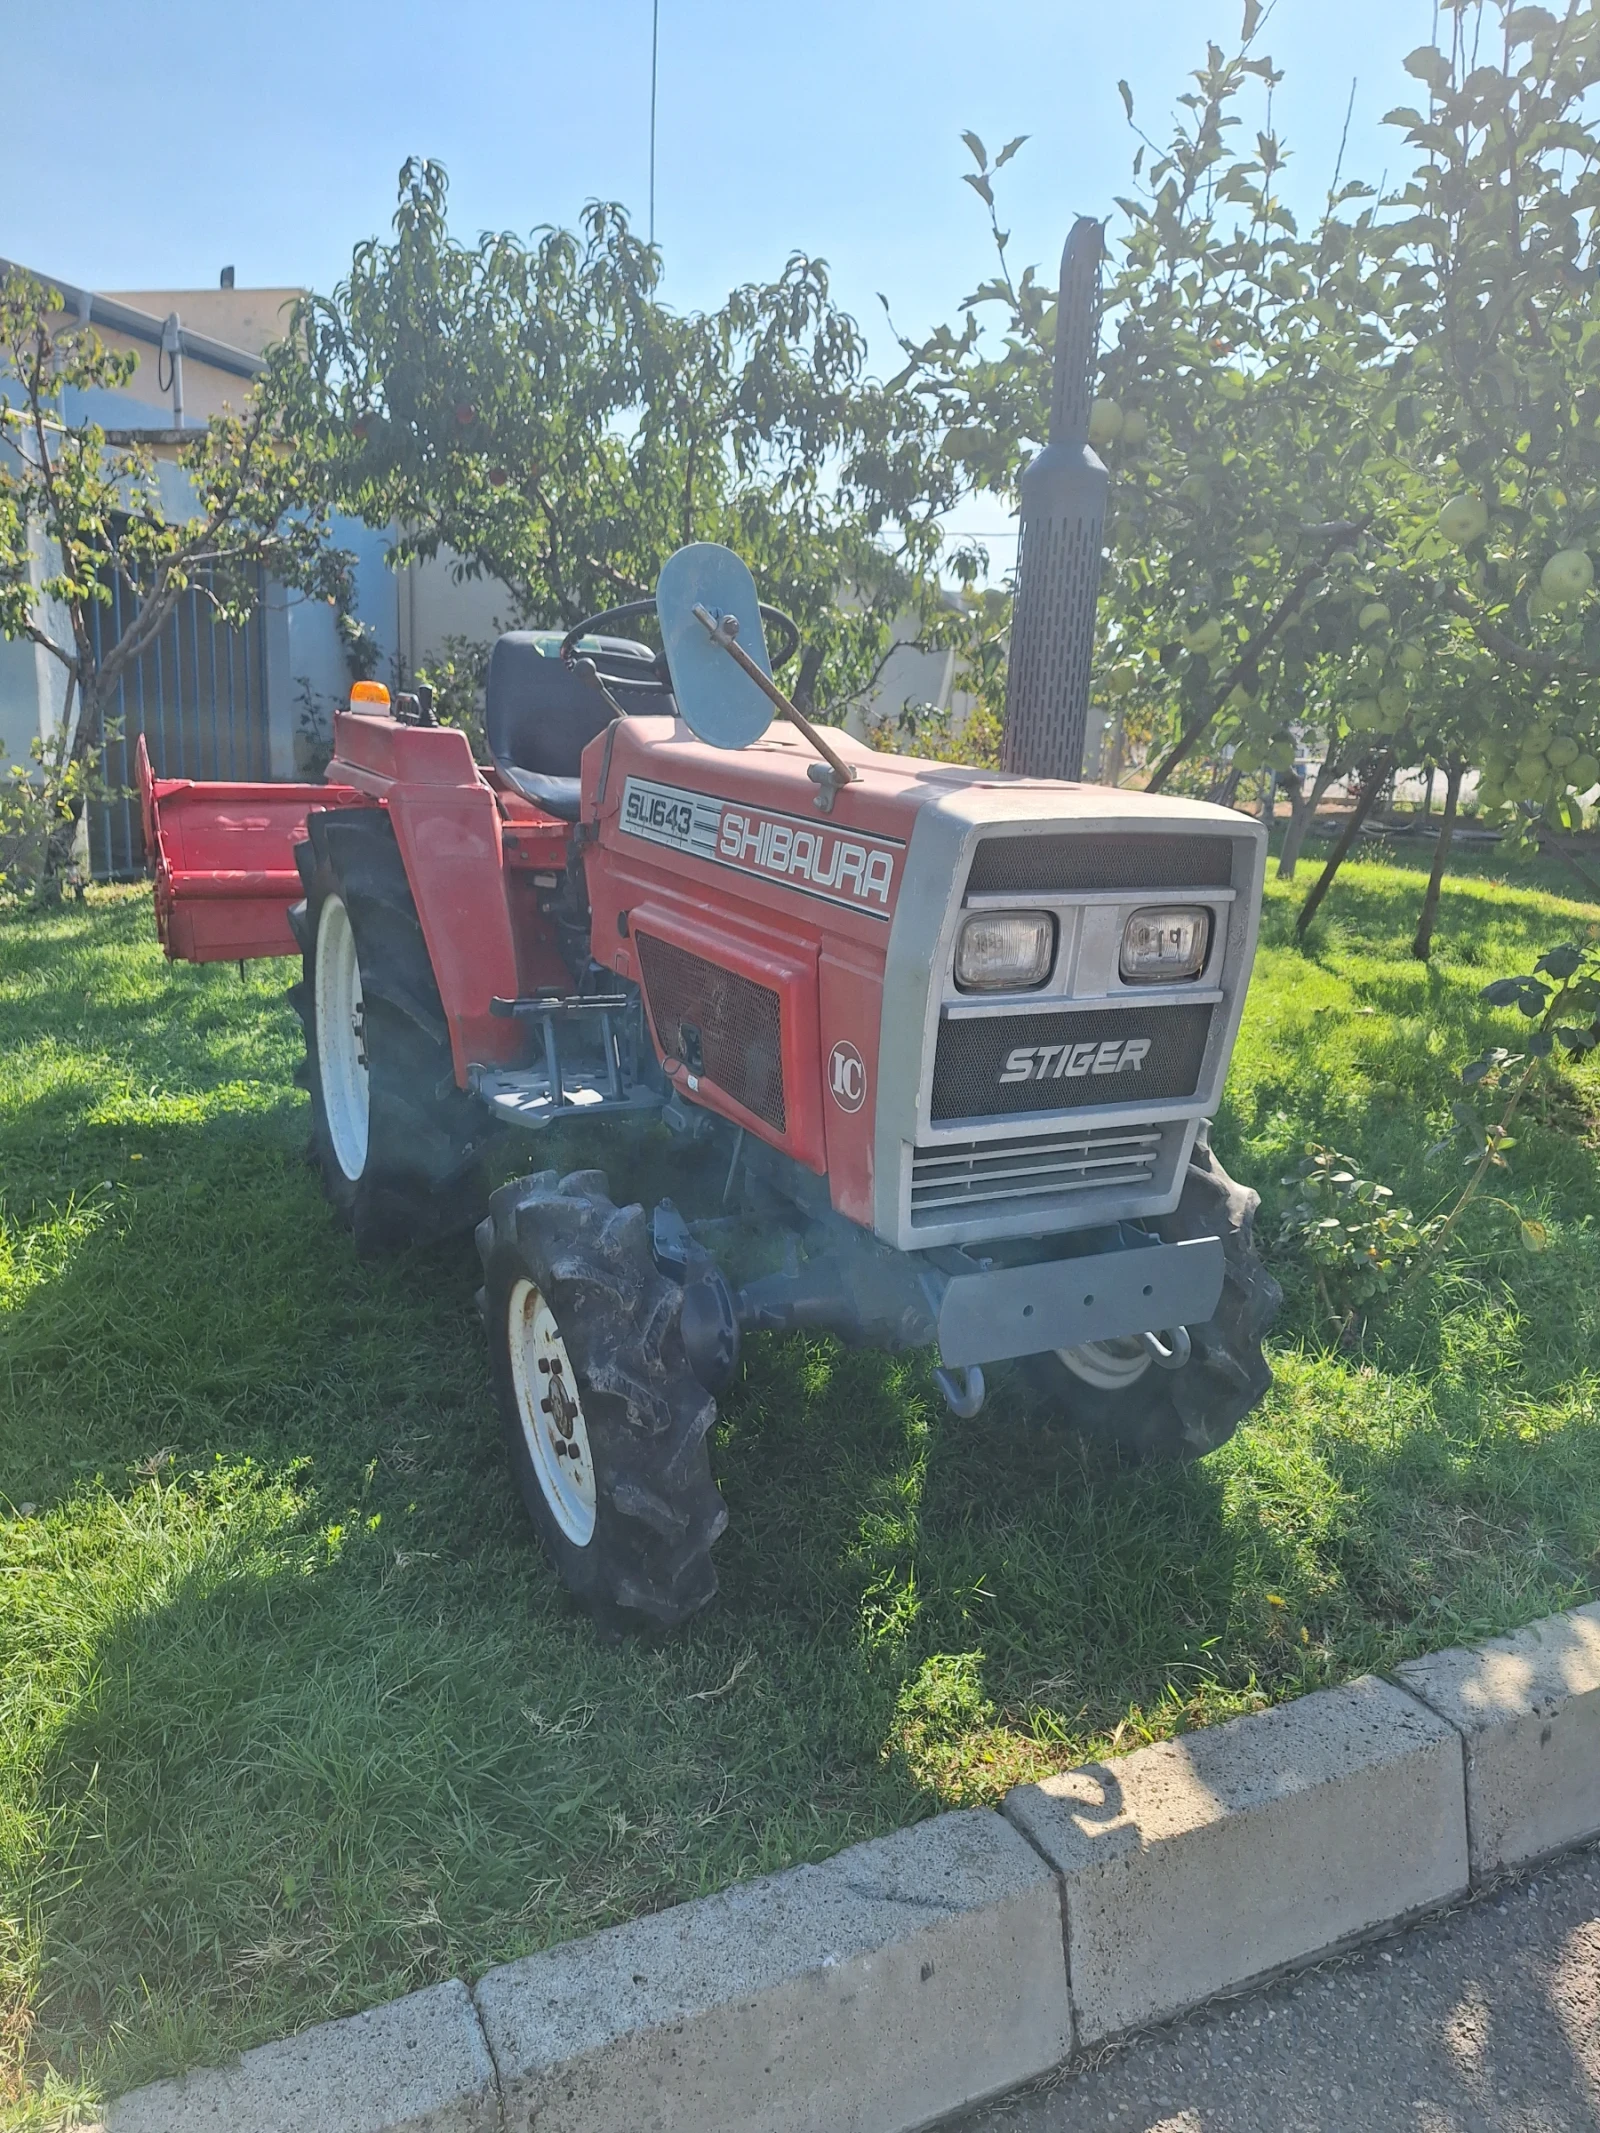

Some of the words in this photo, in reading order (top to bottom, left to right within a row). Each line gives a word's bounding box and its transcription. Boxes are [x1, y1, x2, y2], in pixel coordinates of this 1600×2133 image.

[627, 792, 692, 834] SL1643
[720, 812, 893, 903] SHIBAURA
[833, 1051, 862, 1099] IC
[1000, 1039, 1151, 1083] STIGER
